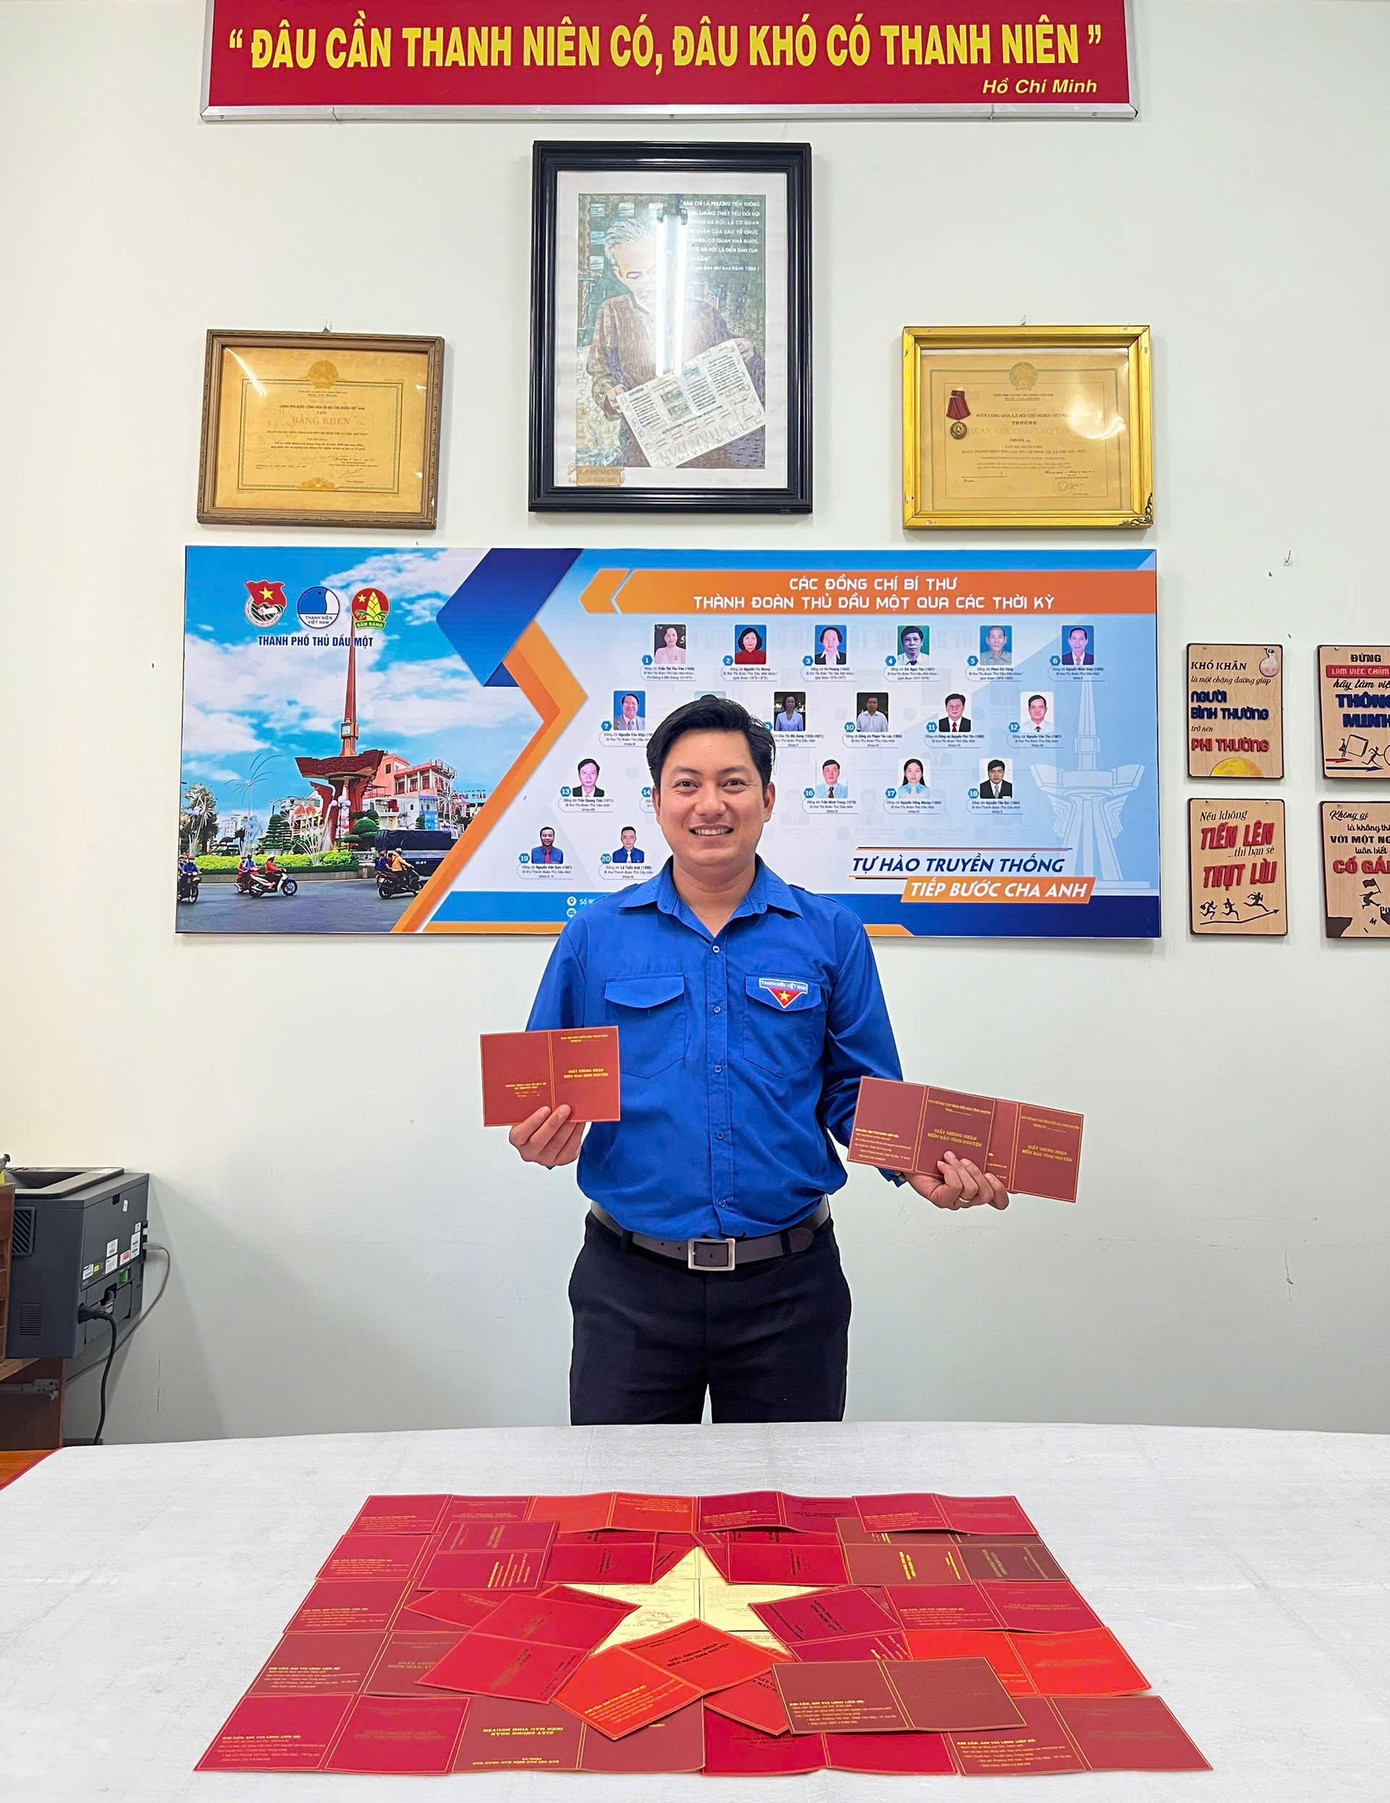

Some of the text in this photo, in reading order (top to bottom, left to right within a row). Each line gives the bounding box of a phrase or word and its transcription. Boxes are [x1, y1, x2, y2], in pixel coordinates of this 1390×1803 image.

[251, 19, 316, 68] ĐÂU
[326, 10, 391, 68] CẦN
[402, 26, 512, 67] THANH
[523, 16, 600, 67] NIÊN
[610, 14, 663, 75] CÓ,
[672, 15, 738, 67] ĐÂU
[750, 14, 817, 67] KHÓ
[827, 13, 870, 66] CÓ
[880, 24, 991, 65] THANH
[1002, 14, 1079, 64] NIÊN
[982, 77, 1097, 94] Hồ Chí Minh
[789, 573, 958, 591] CÁC ĐỒNG CHÍ BÍ THƯ
[693, 592, 1055, 611] THÀNH ĐOÀN THỦ DẦU MỘT QUA CÁC THỜI KỲ
[291, 633, 310, 646] PHỐ
[312, 633, 330, 646] THỦ
[354, 635, 374, 649] MỘT
[1191, 660, 1247, 670] KHÓ KHĂN
[1350, 652, 1382, 663] ĐỪNG
[1354, 678, 1375, 689] làm
[1191, 736, 1270, 752] PHI THƯỜNG
[1200, 810, 1248, 822] Nếu không
[1201, 819, 1275, 850] TIẾN LÊN
[1330, 834, 1348, 844] VỚI
[1351, 834, 1375, 845] MỘT
[852, 852, 1065, 874] TỰ HÀO TRUYỀN THỐNG
[1332, 856, 1358, 875] CỐ
[1203, 858, 1278, 891] THỤT LÙI
[911, 877, 1088, 898] TIẾP BƯỚC CHA ANH
